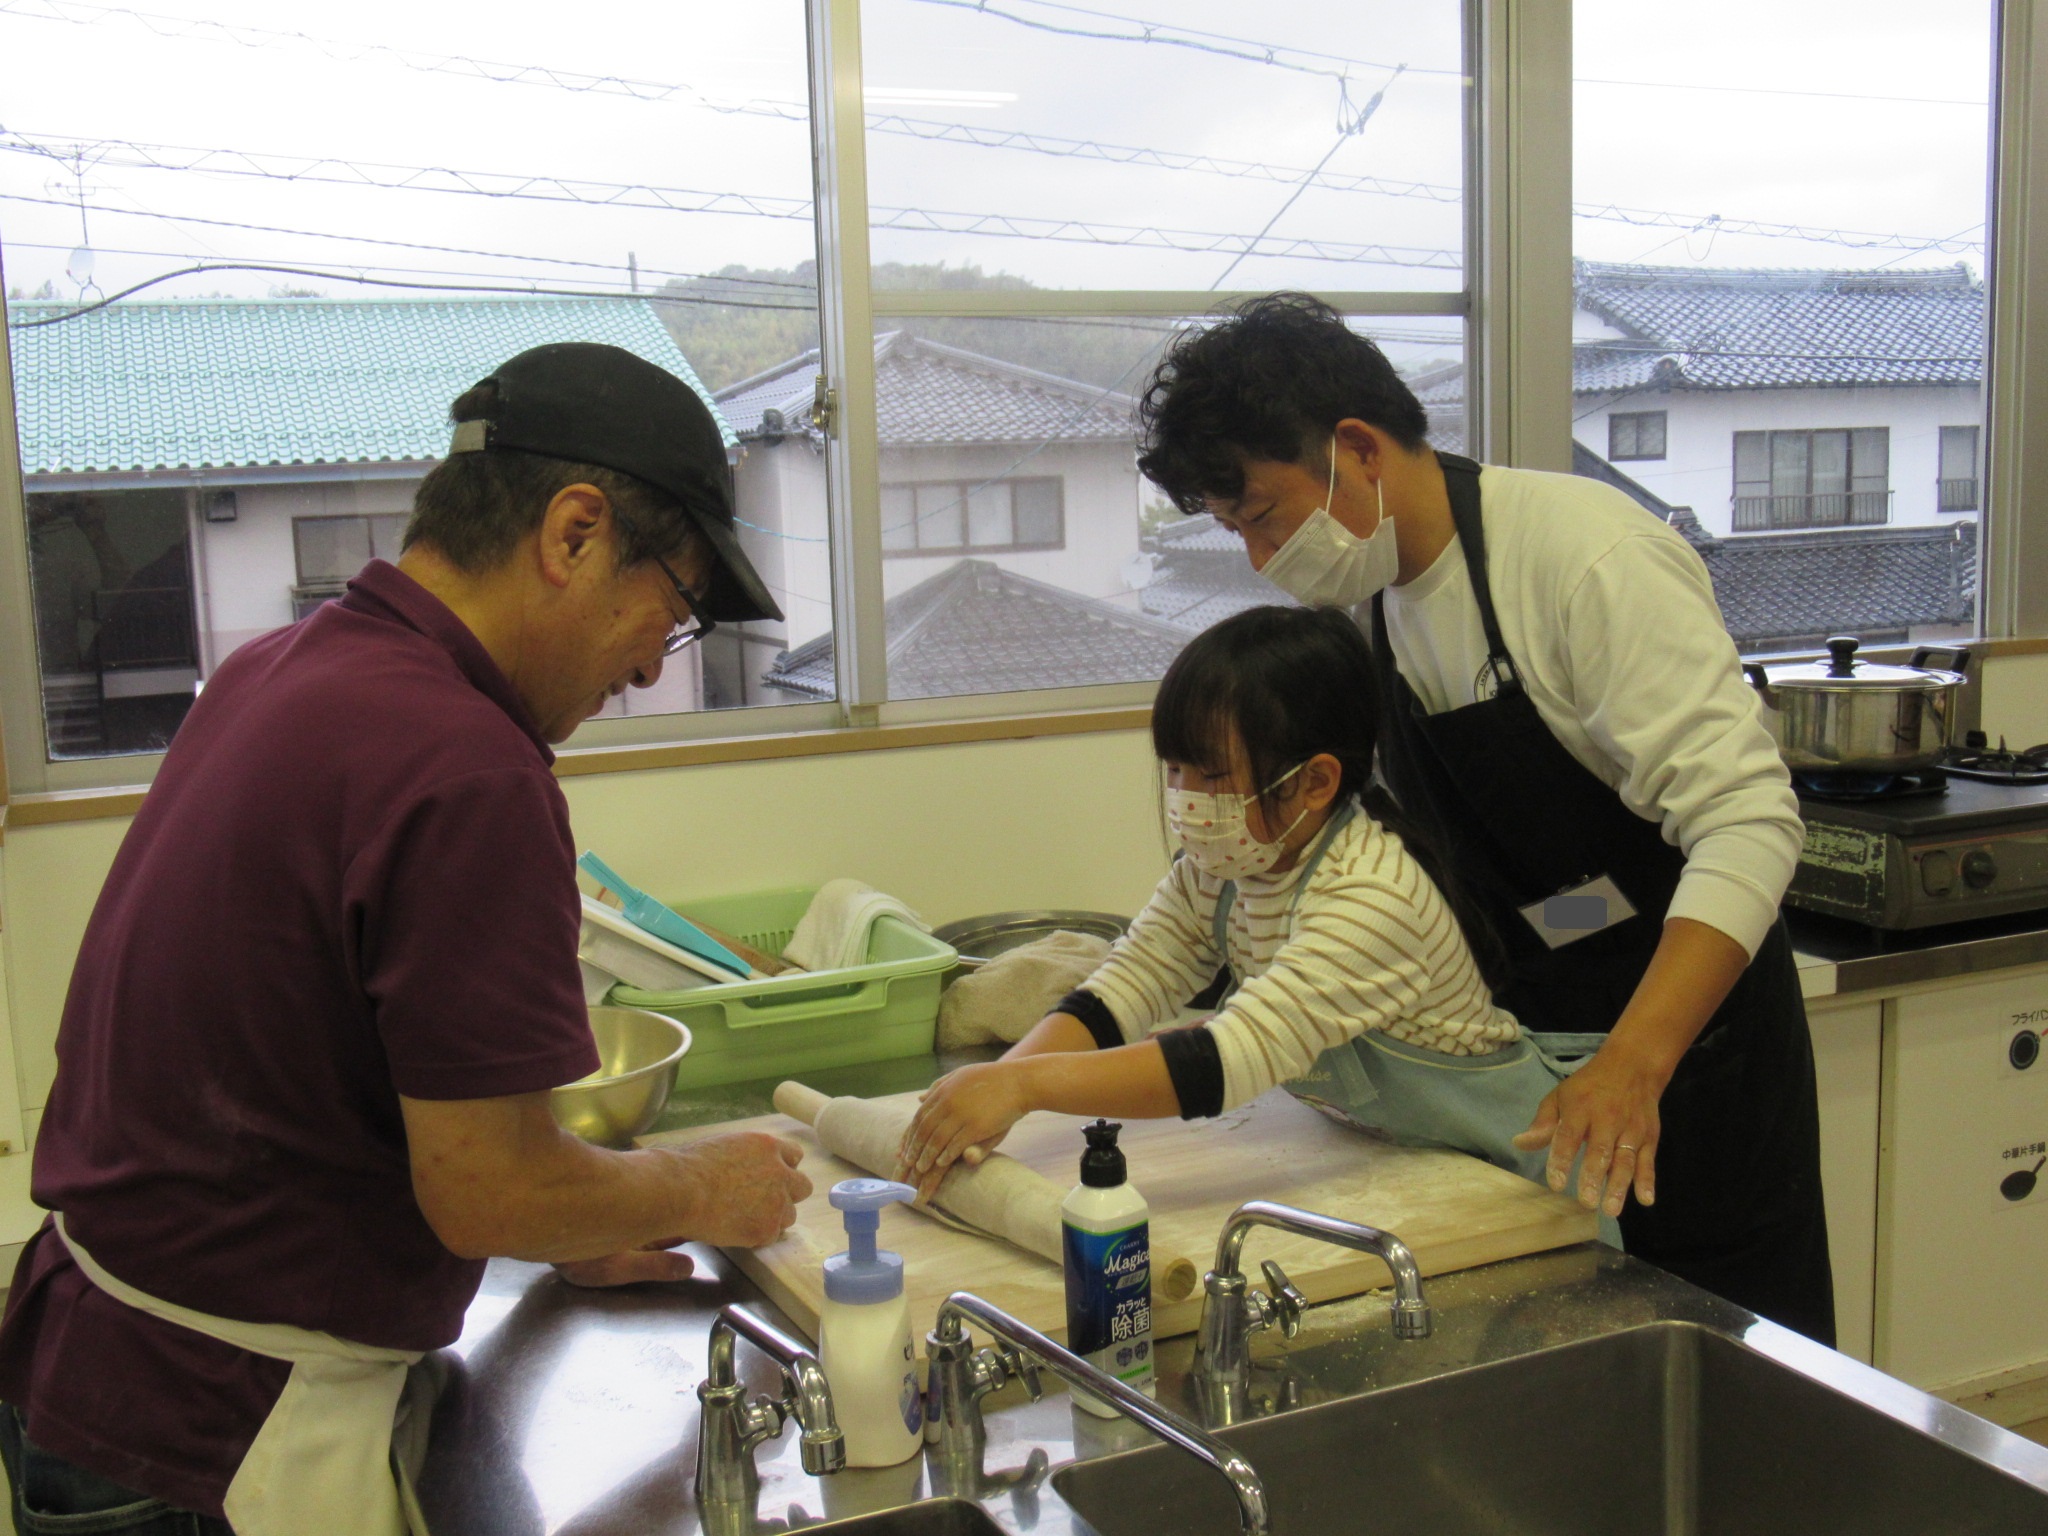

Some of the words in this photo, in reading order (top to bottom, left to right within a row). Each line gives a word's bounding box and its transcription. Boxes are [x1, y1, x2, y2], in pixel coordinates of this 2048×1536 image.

[1116, 1297, 1146, 1315] カラッと
[1111, 1306, 1149, 1342] 除菌
